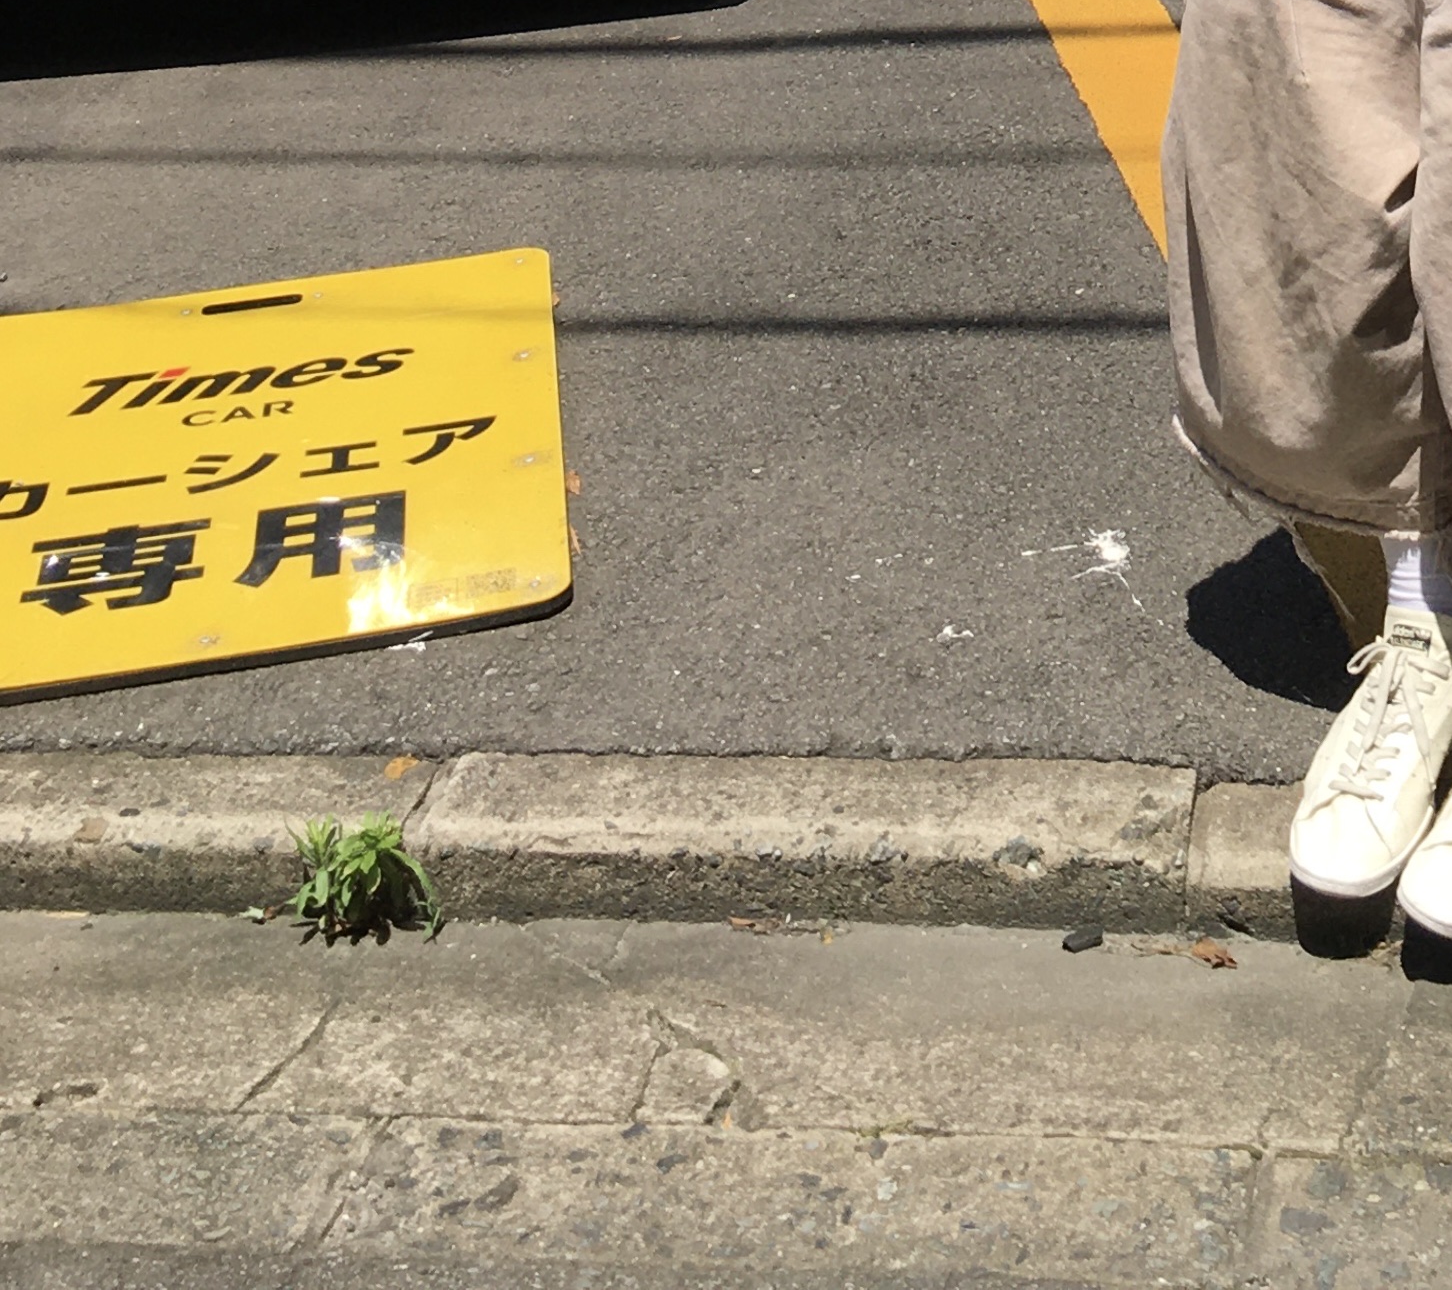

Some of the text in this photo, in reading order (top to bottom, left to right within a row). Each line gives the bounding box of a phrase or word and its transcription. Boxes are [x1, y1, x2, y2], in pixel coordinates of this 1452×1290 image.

[66, 348, 415, 417] Times
[181, 399, 295, 427] CAR
[20, 490, 407, 616] 専用
